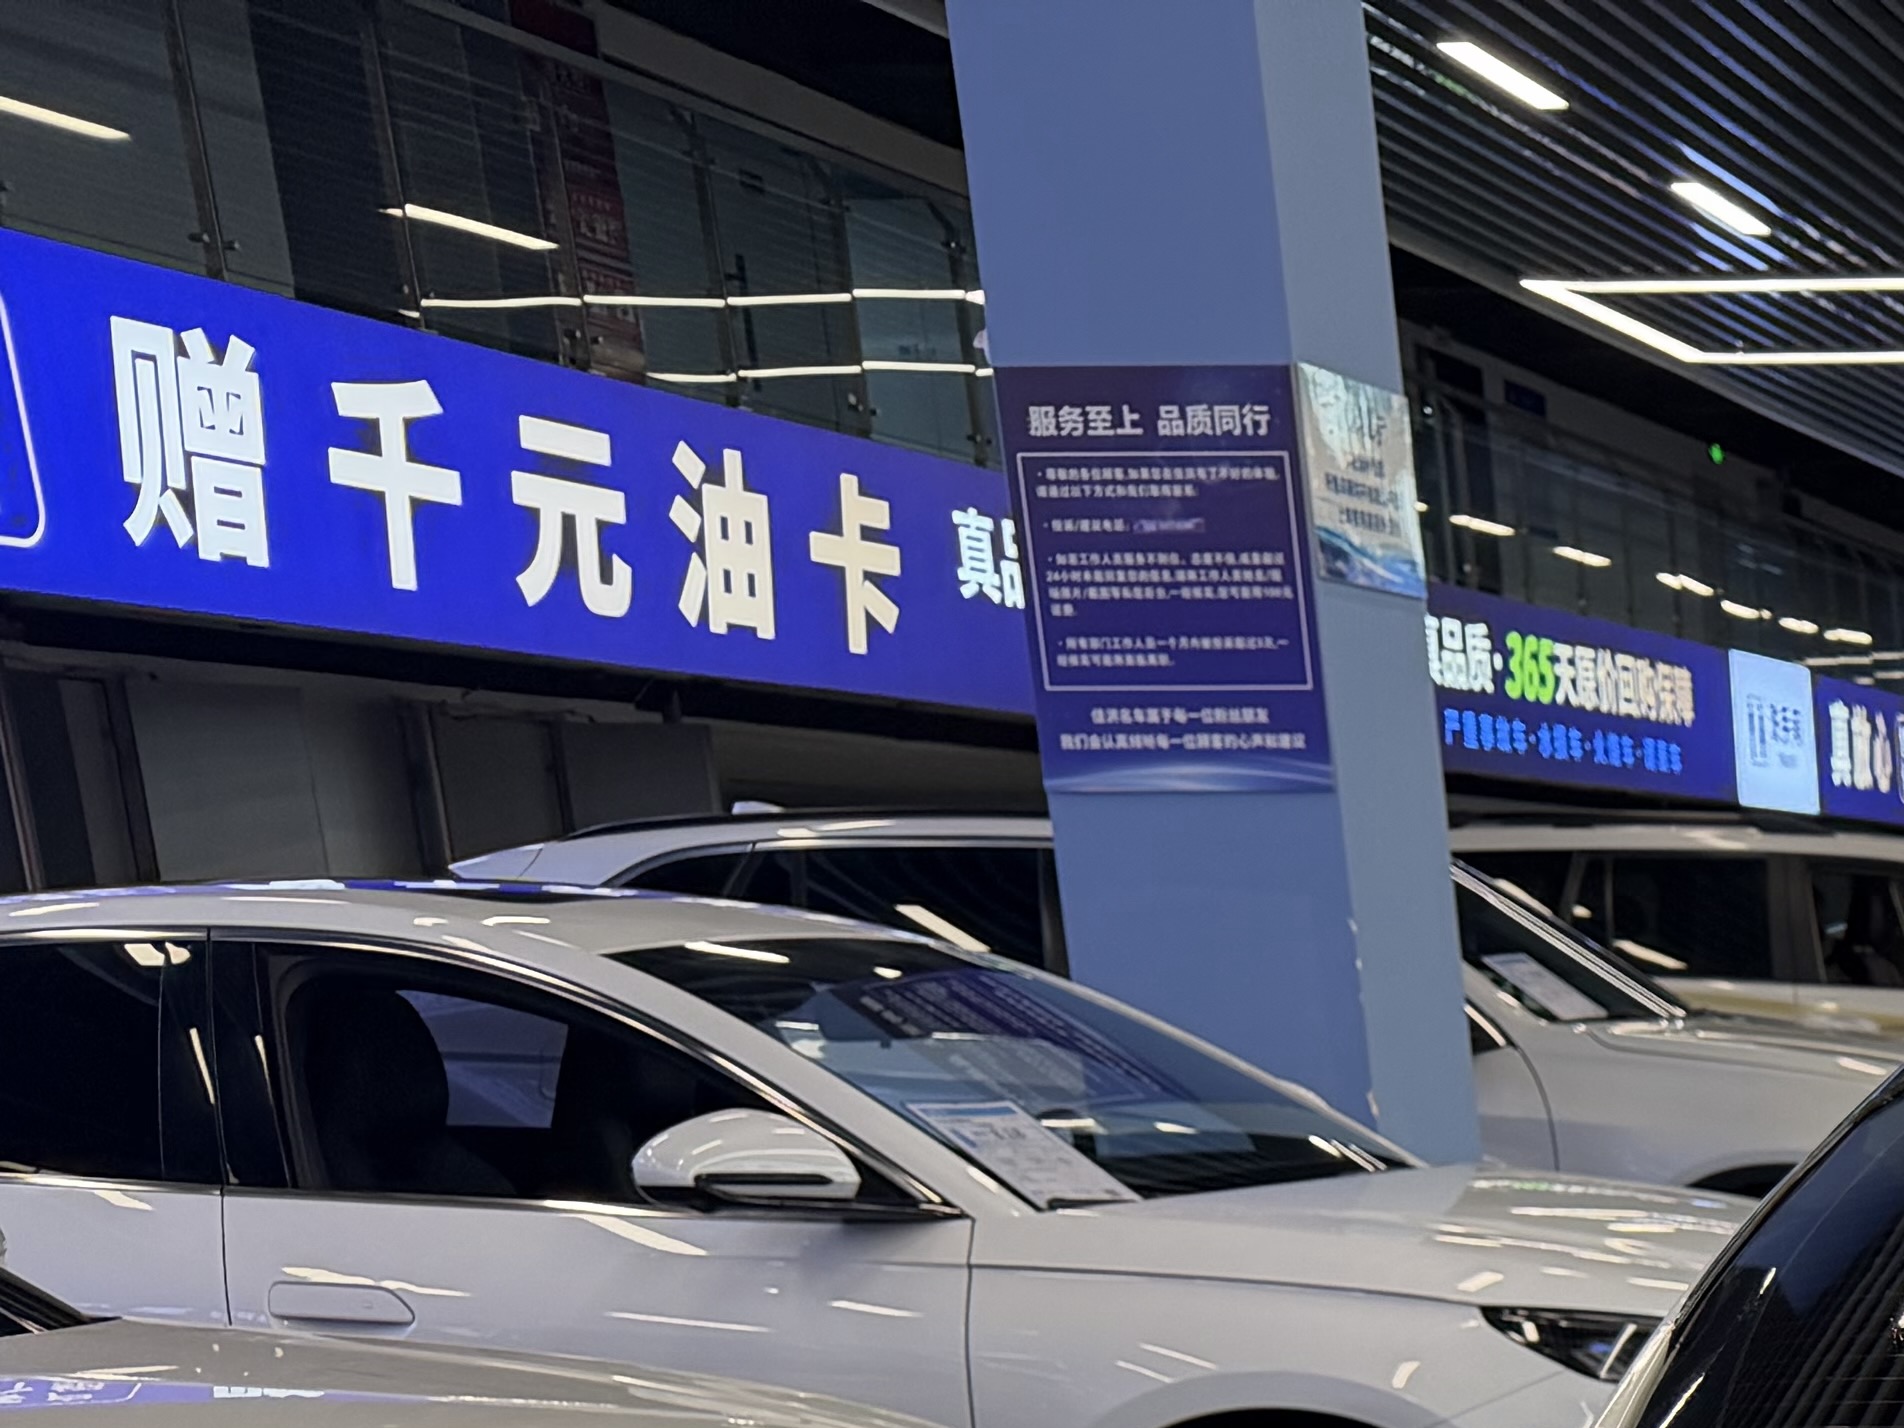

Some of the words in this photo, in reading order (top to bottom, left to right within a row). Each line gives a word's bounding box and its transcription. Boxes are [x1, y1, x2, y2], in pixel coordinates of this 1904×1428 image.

[109, 314, 903, 657] 赠千元油卡
[1028, 404, 1144, 438] 服务至上
[1157, 403, 1272, 438] 品质同行
